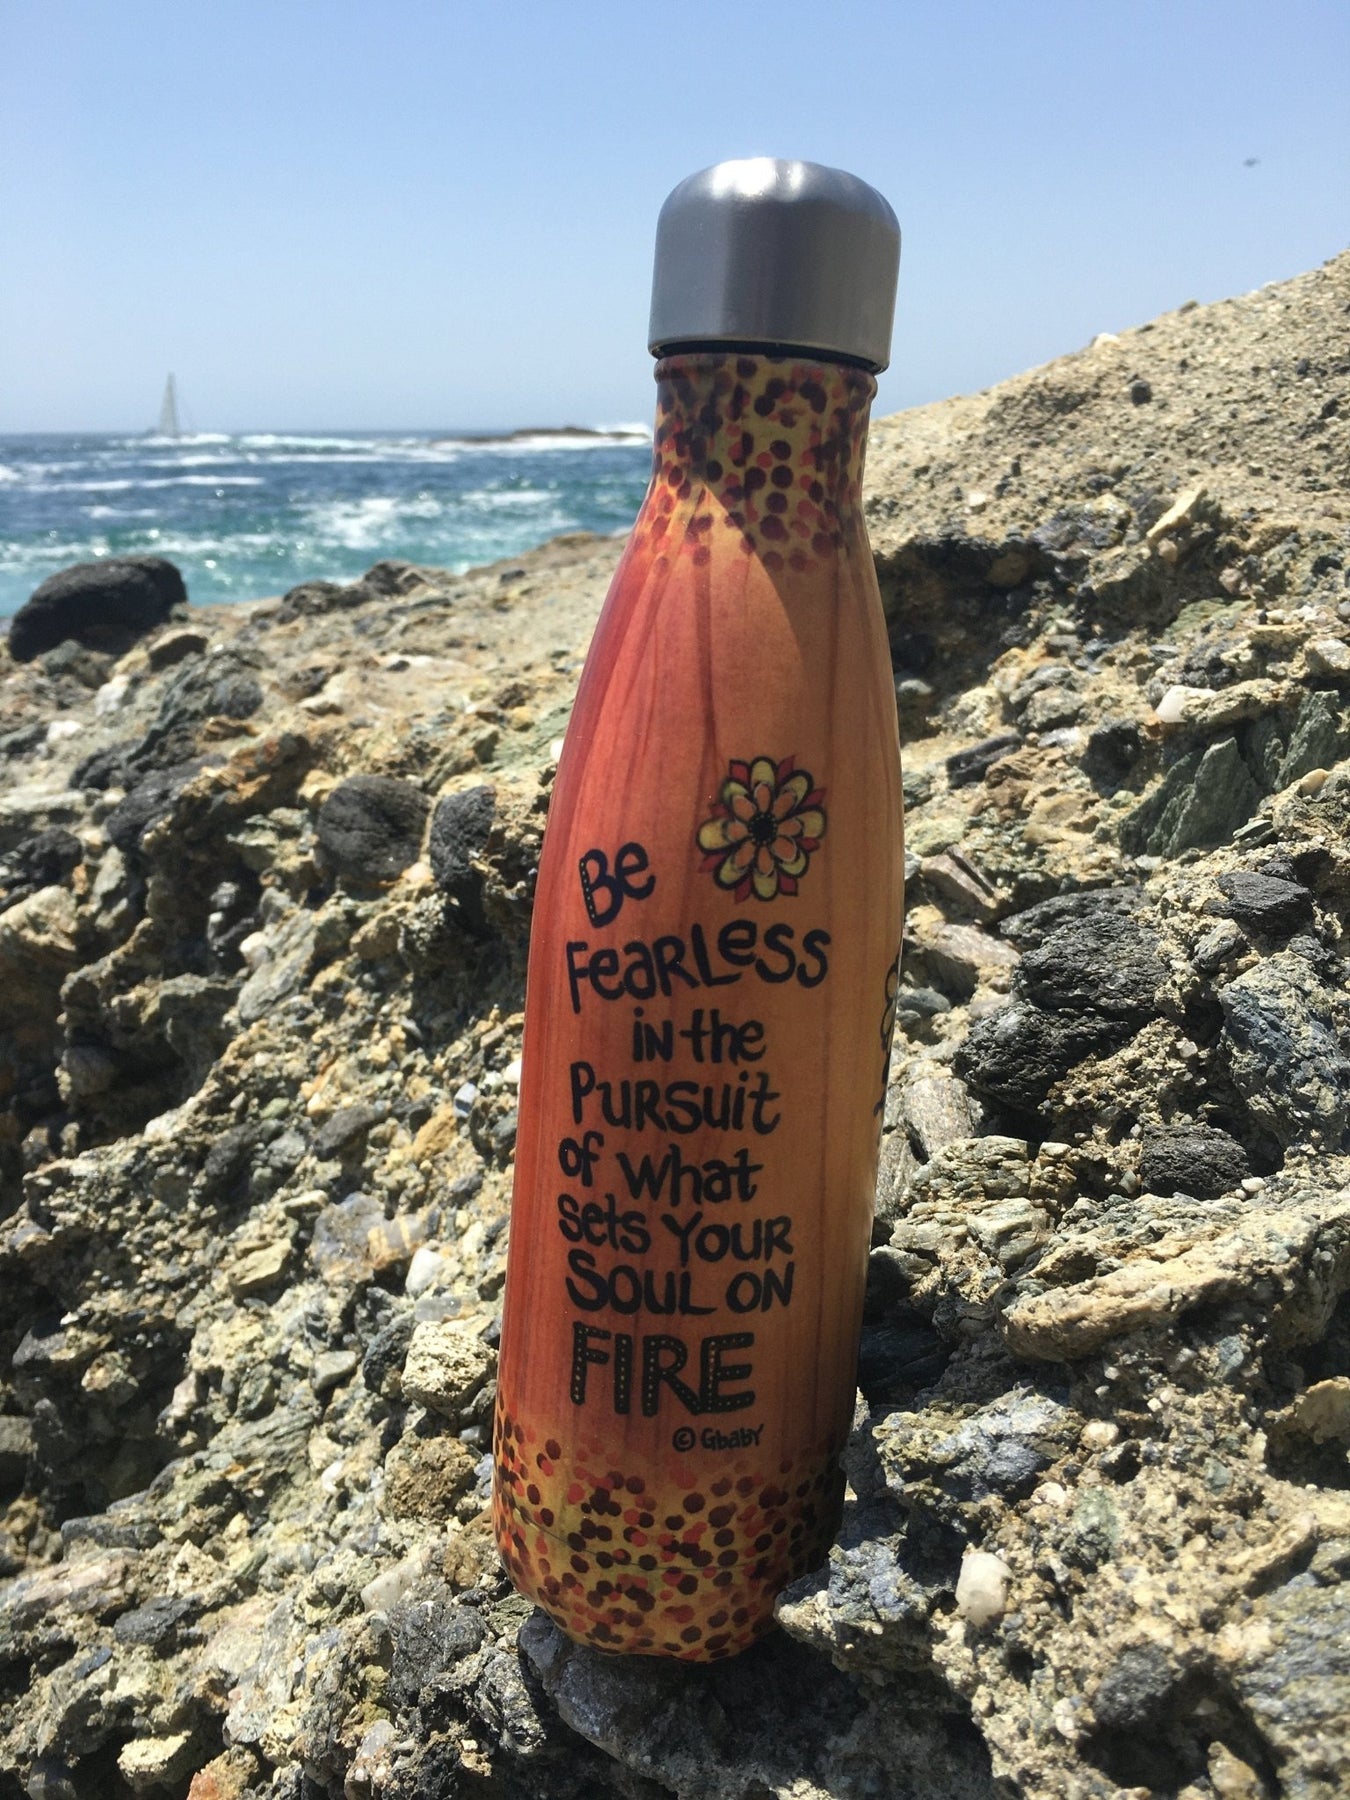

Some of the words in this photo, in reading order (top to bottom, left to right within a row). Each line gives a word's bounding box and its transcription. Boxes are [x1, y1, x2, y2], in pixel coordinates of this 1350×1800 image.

[579, 842, 655, 927] Be
[680, 1008, 766, 1066] the
[558, 1131, 605, 1186] of
[570, 1321, 755, 1417] FIRE
